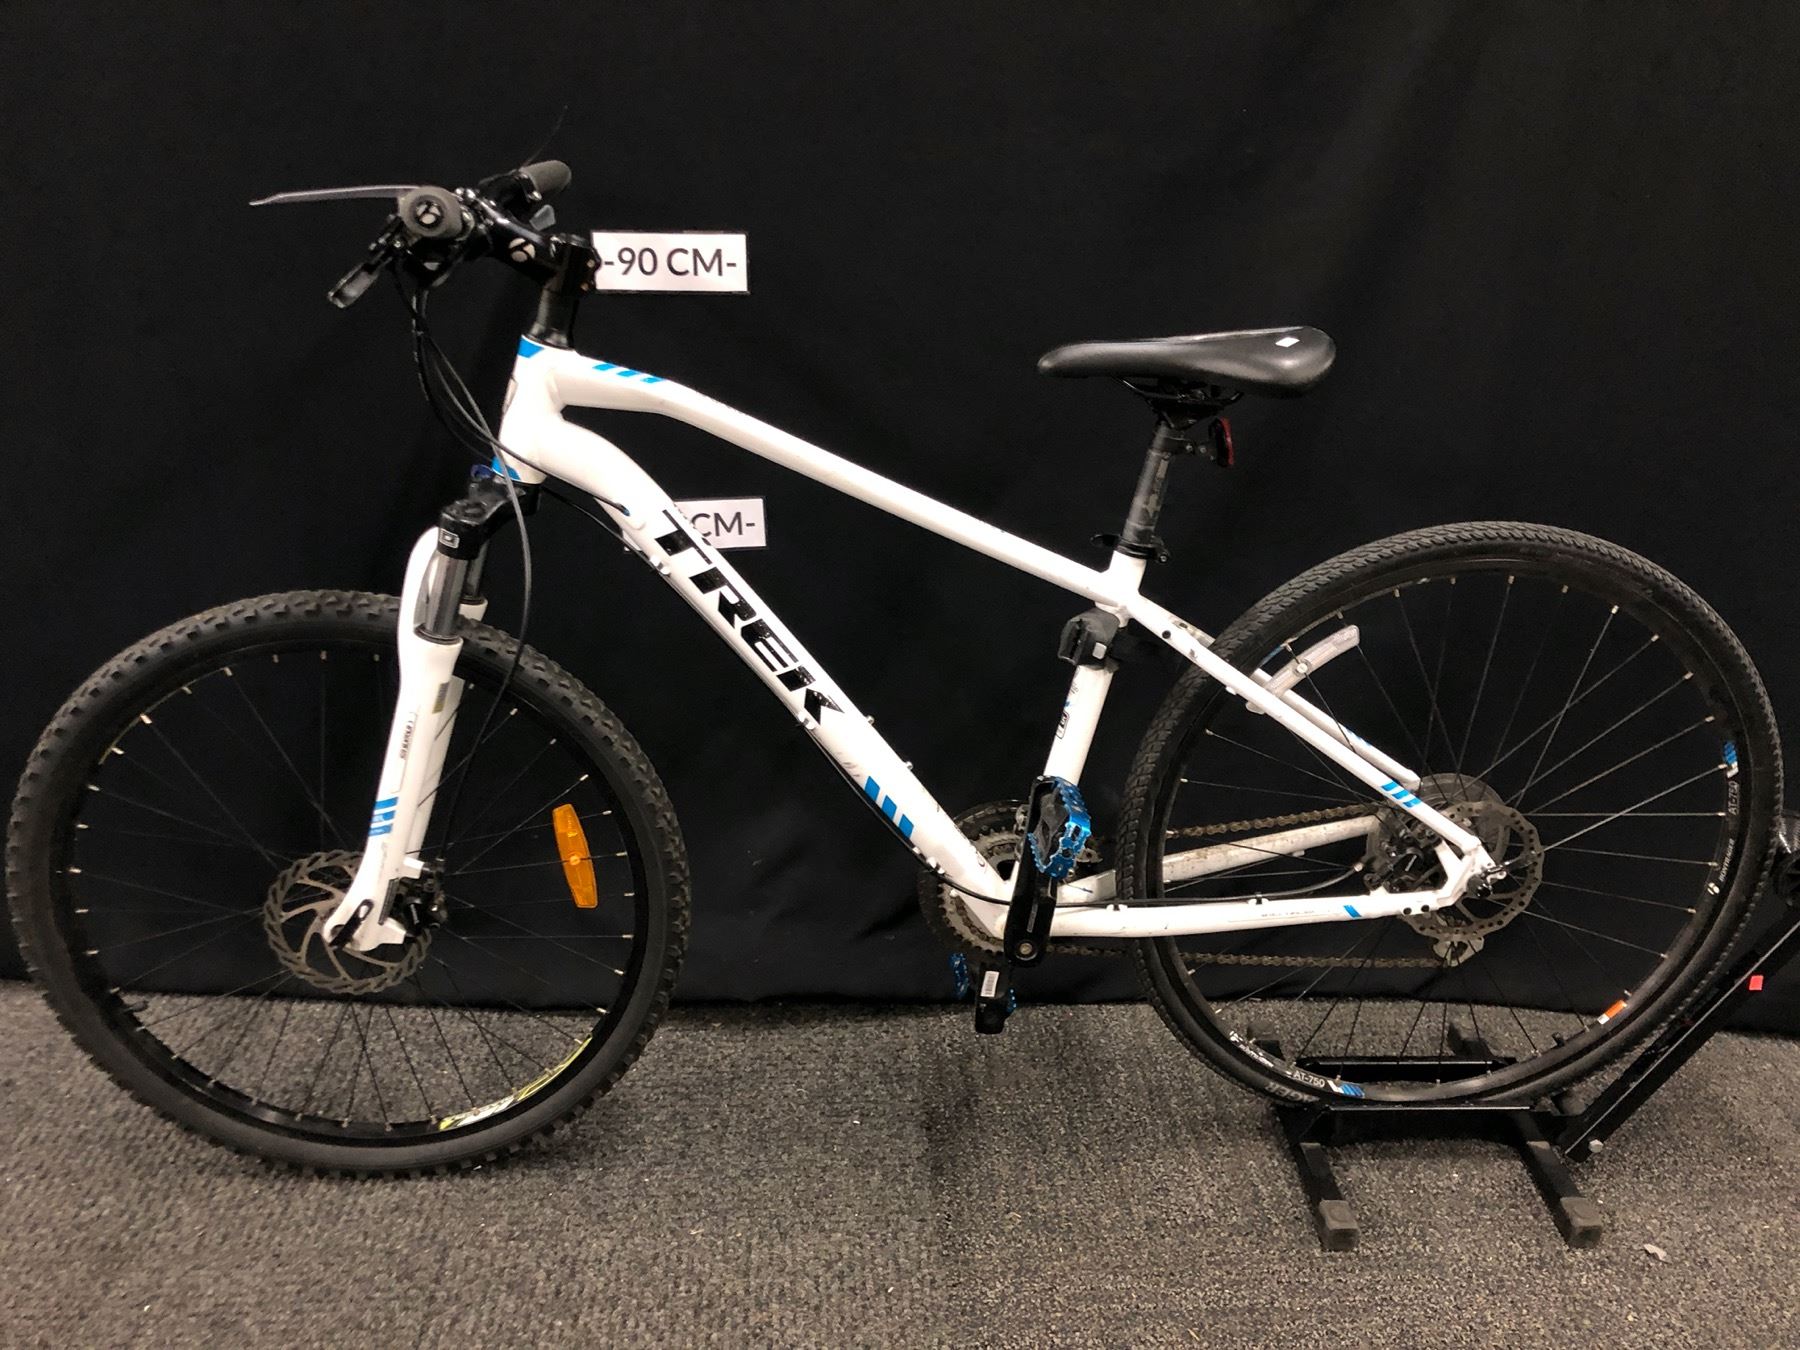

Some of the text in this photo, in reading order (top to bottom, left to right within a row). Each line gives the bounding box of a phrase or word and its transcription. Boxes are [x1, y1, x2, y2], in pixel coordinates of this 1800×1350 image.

[604, 247, 737, 277] -90 CM-
[691, 511, 756, 538] CM-
[655, 509, 845, 725] TREK
[1293, 1070, 1326, 1088] AT-750
